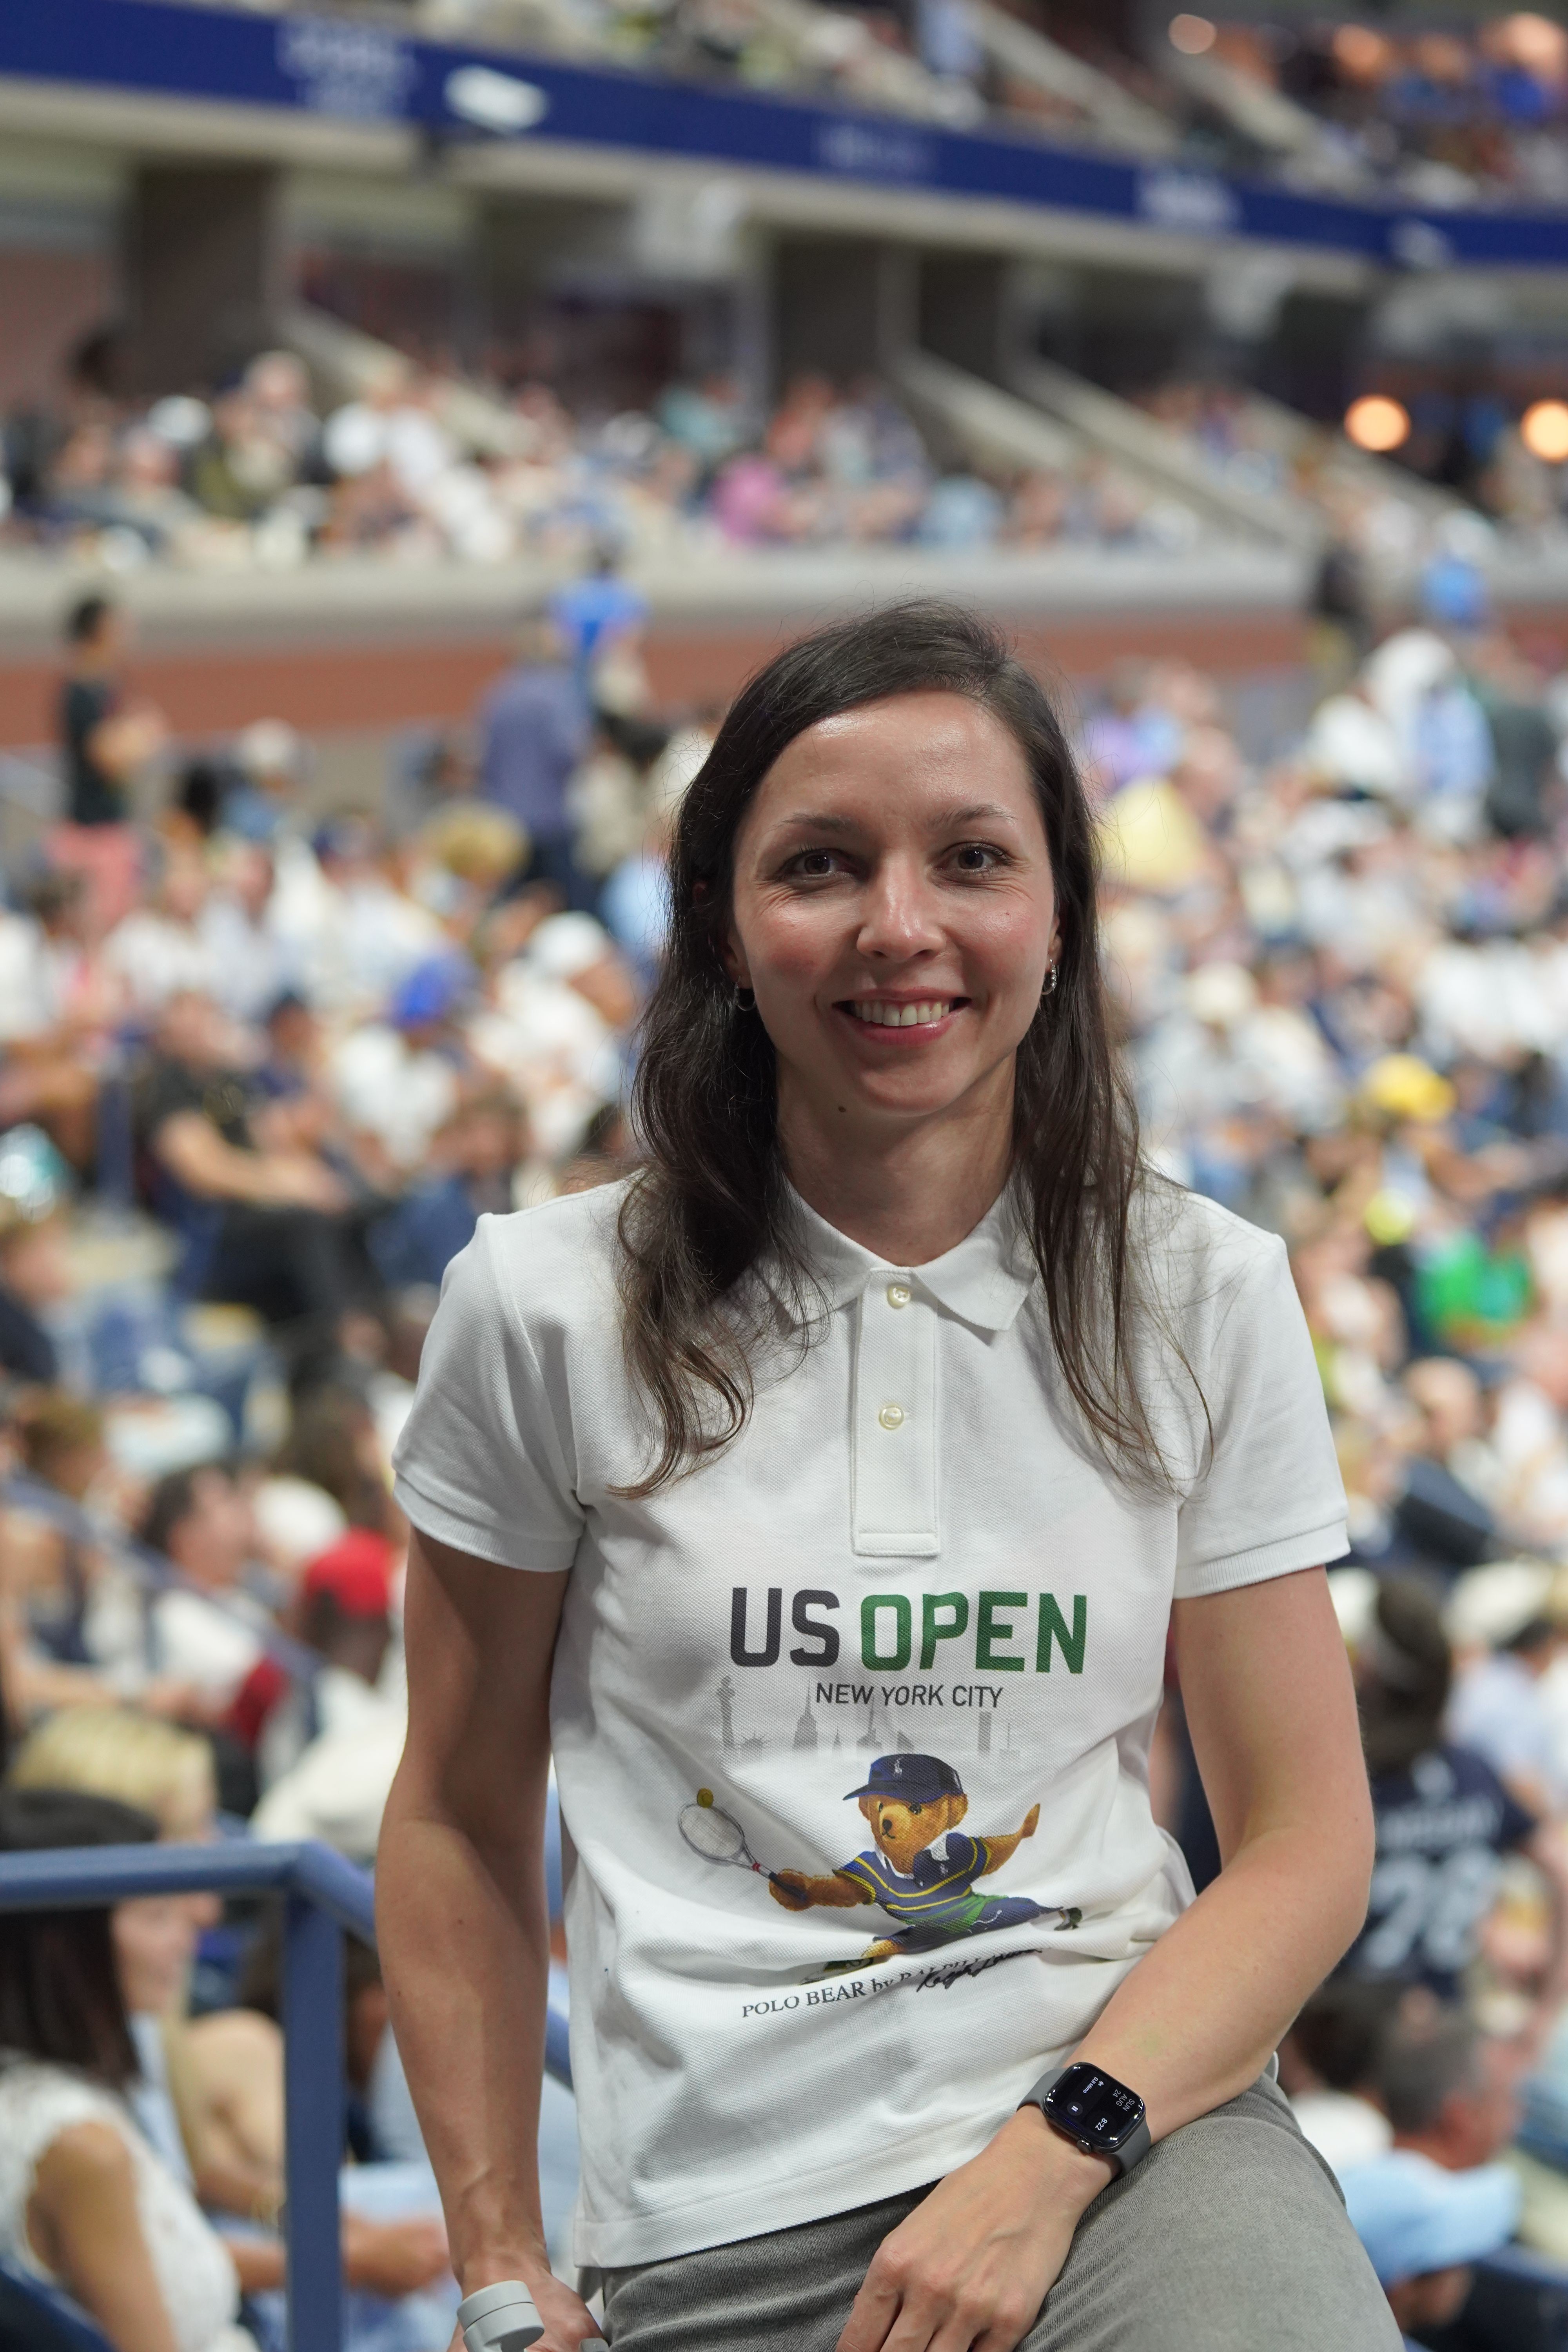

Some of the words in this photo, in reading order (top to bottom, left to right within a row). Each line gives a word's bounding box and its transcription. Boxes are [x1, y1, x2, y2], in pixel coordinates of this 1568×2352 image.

[730, 1587, 840, 1668] US
[860, 1591, 1087, 1674] OPEN
[816, 1682, 875, 1704] NEW
[881, 1684, 944, 1706] YORK
[952, 1685, 1004, 1708] CITY
[742, 1996, 800, 2018] POLO
[806, 1981, 867, 2006] BEAR
[870, 1978, 894, 1993] by
[1083, 2082, 1094, 2094] Mimo
[1112, 2089, 1121, 2098] 24
[1116, 2094, 1127, 2107] AUG
[1122, 2098, 1135, 2112] SUN
[1095, 2118, 1108, 2131] 8:22
